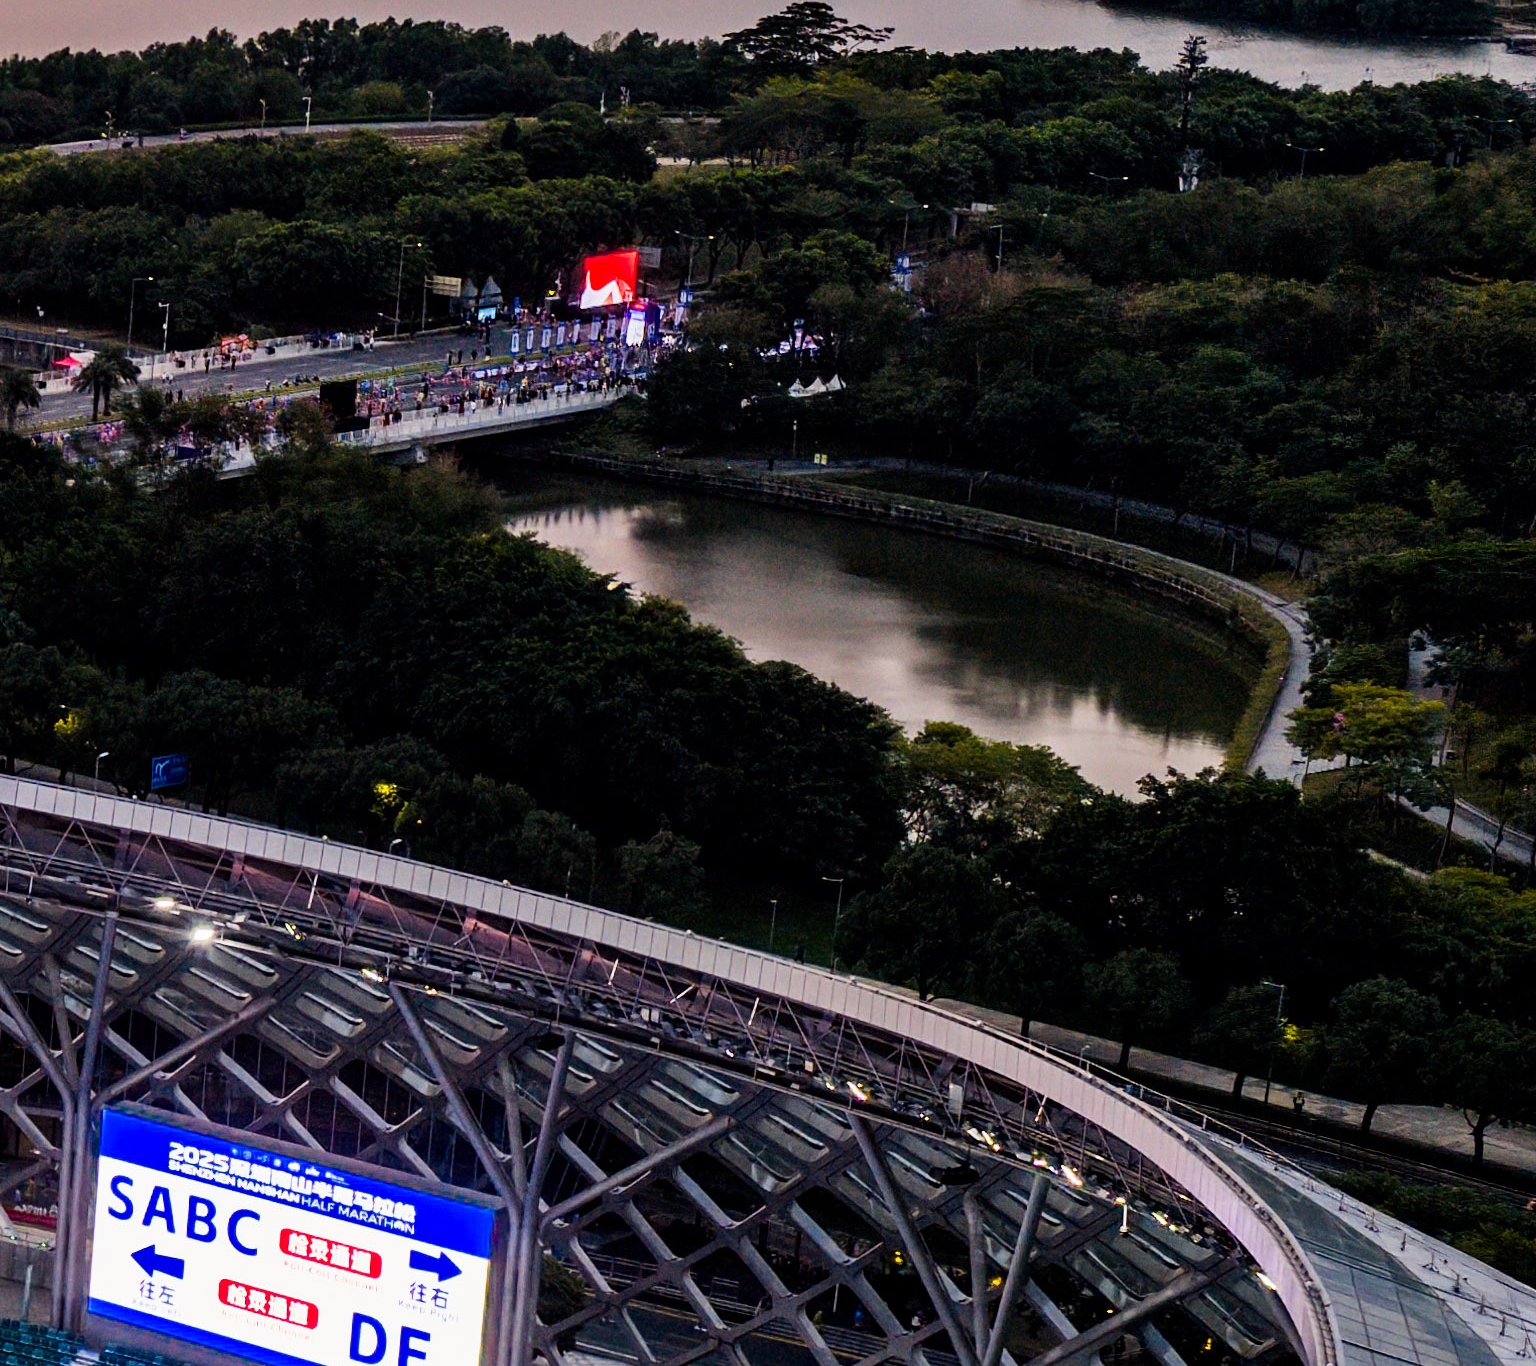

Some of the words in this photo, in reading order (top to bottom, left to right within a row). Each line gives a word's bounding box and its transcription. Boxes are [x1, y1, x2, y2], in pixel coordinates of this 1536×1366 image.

[108, 1175, 260, 1256] SABC
[168, 1160, 236, 1187] SHENZHEN
[237, 1177, 300, 1203] NANSHAN
[301, 1196, 334, 1215] HALF
[338, 1206, 415, 1235] MARATHON
[139, 1279, 175, 1308] 往左
[409, 1281, 449, 1309] 往右
